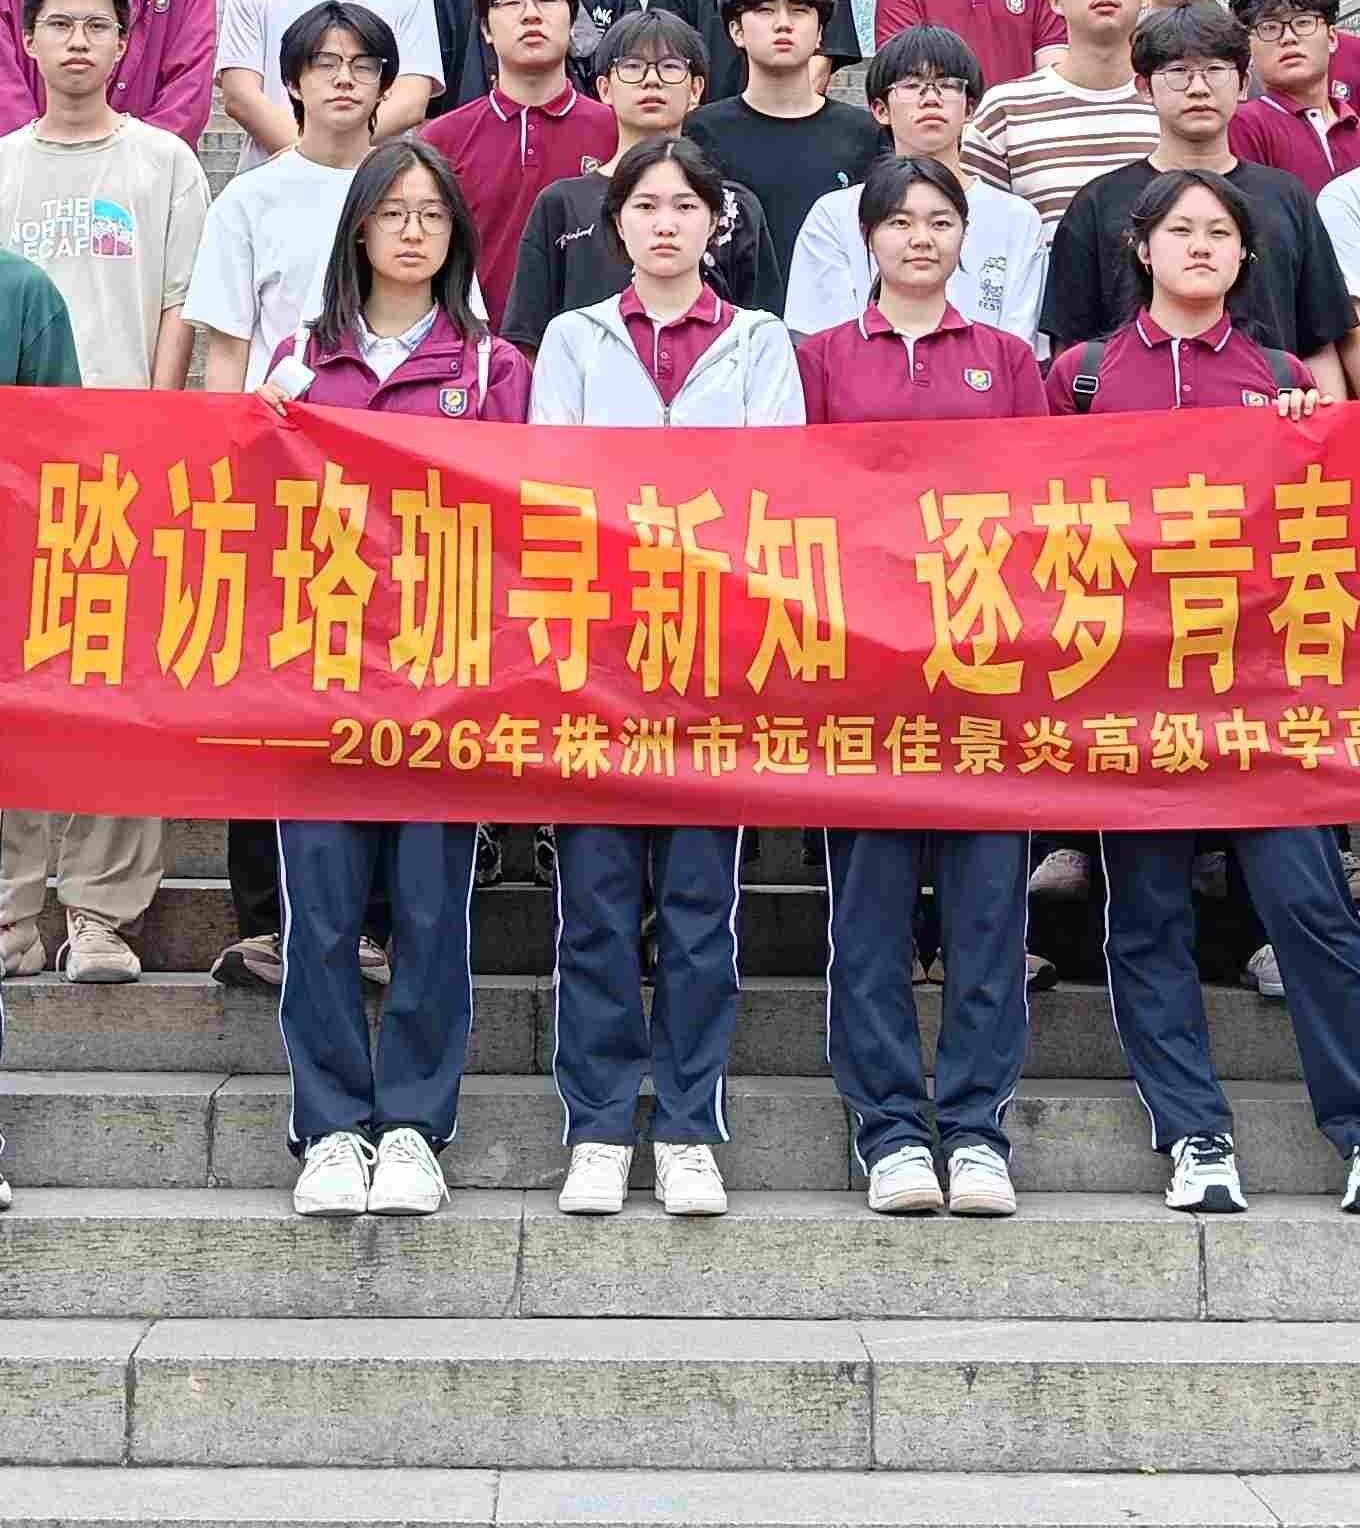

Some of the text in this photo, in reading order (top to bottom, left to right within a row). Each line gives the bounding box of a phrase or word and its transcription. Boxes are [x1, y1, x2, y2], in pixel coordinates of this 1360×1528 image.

[41, 199, 90, 217] THE
[23, 452, 847, 698] 踏访珞珈寻新知
